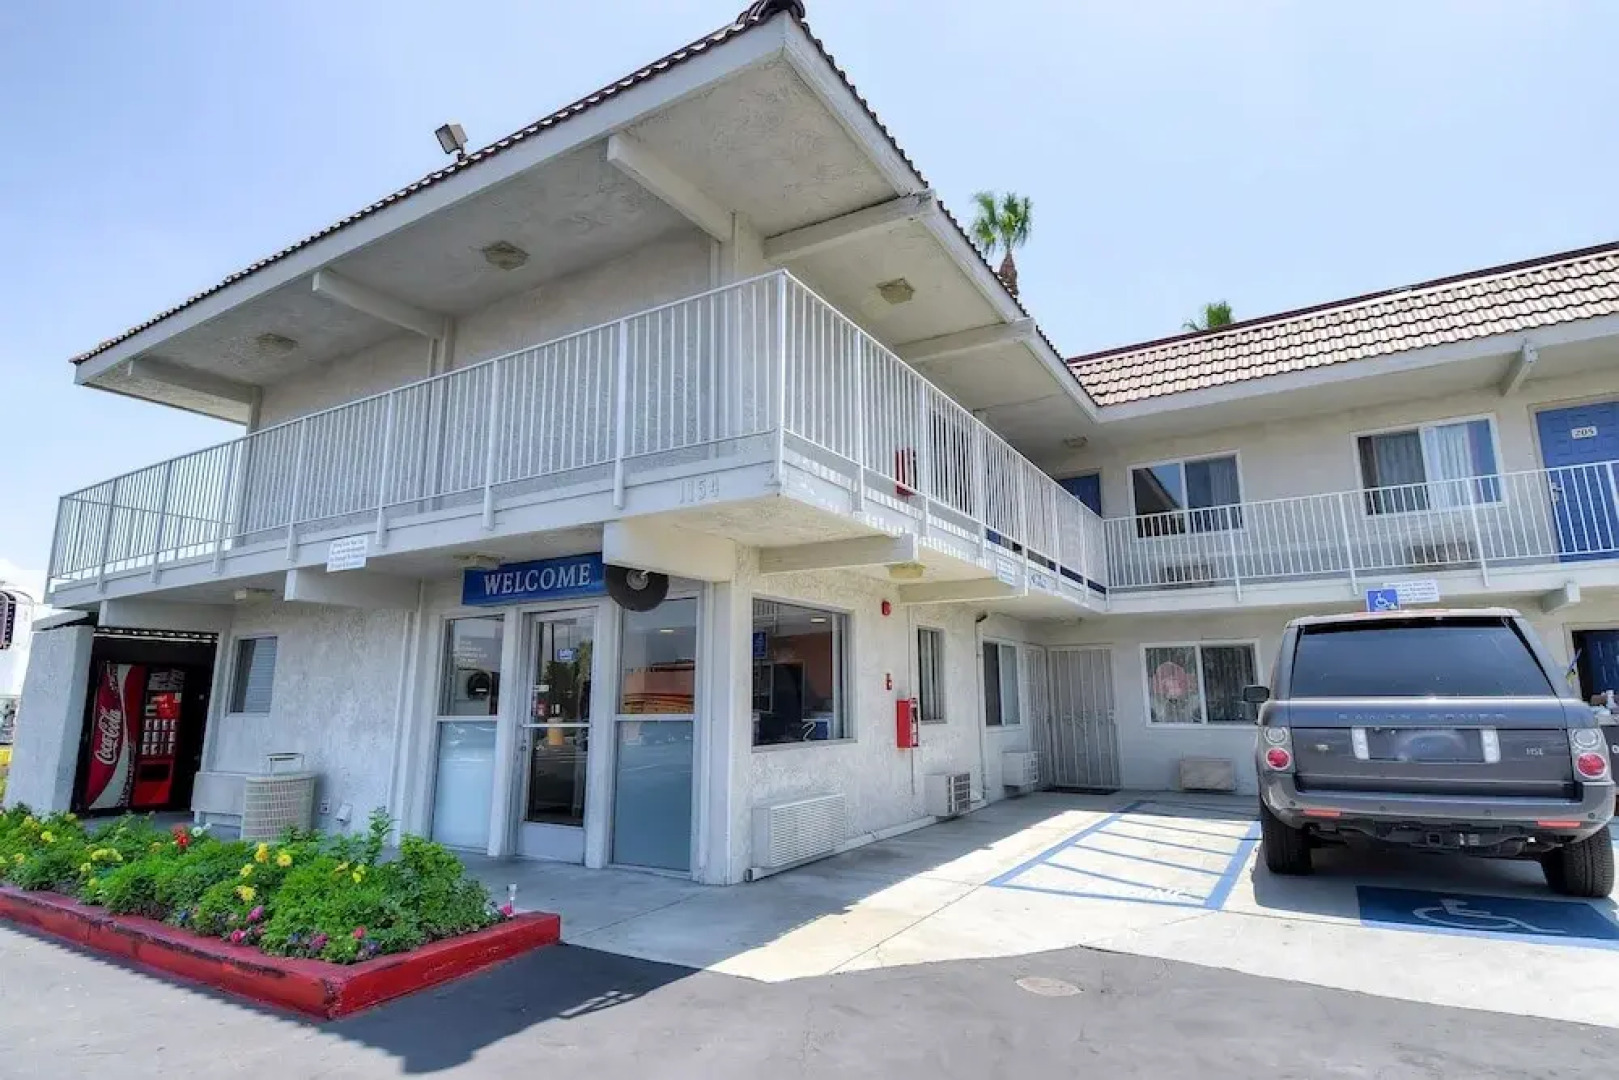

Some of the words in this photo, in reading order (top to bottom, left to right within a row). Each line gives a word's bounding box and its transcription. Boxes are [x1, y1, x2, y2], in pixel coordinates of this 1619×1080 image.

[679, 475, 720, 505] 1154
[484, 563, 592, 596] WELCOME
[95, 706, 122, 765] Coca-Cola
